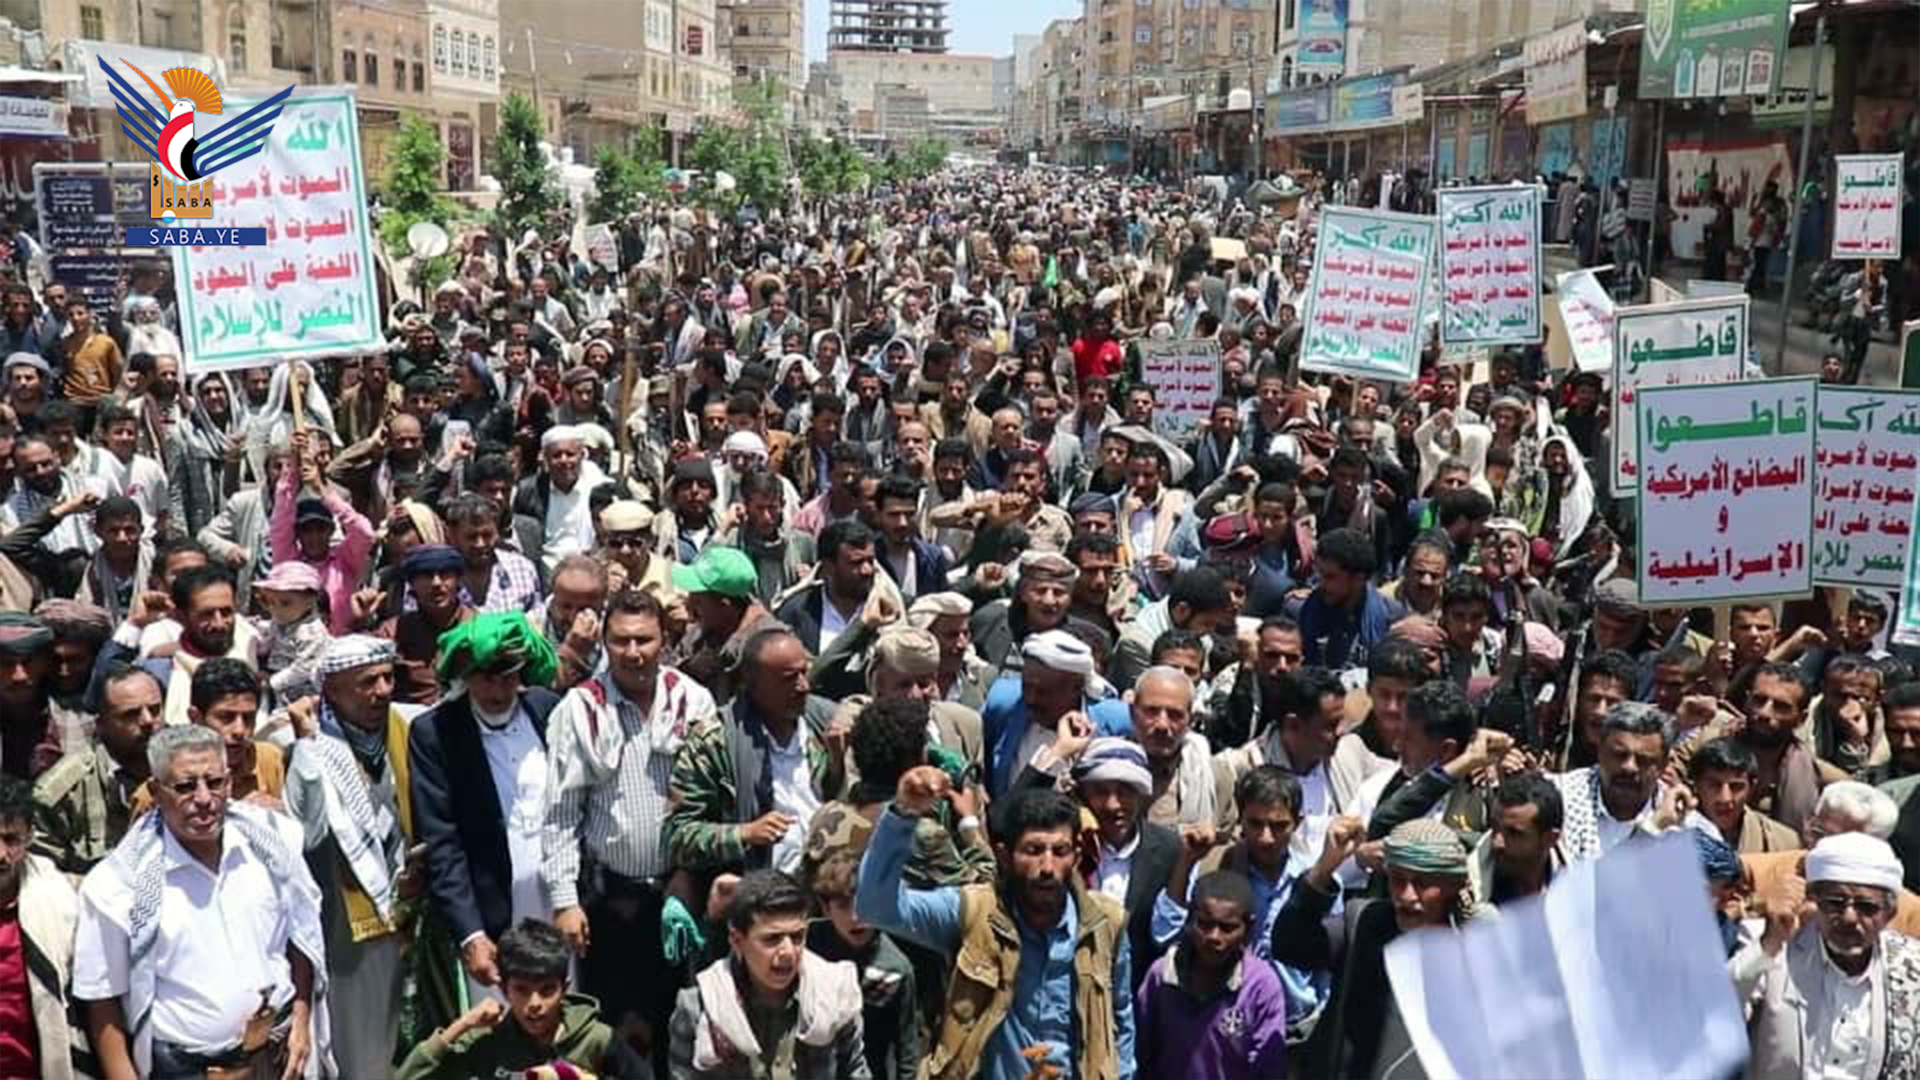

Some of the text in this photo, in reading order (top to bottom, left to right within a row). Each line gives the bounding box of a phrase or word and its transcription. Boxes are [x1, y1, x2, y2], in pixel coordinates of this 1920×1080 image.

[286, 112, 346, 150] الله
[280, 166, 350, 201] الموت
[1840, 164, 1897, 193] قاطعوا
[285, 209, 354, 244] الموت
[1445, 196, 1532, 232] الله أكبر
[1328, 220, 1427, 254] الله أكبر
[193, 251, 360, 297] اللعنة على اليهود
[200, 287, 365, 346] النصر للإسلام
[1622, 314, 1738, 376] قاطعوا
[1646, 397, 1807, 453] قاطعوا
[1647, 454, 1729, 500] الأمريكية
[1732, 456, 1804, 495] البضائع
[1717, 504, 1729, 533] و
[1840, 512, 1870, 536] على
[1648, 540, 1803, 585] الإسرائيلية
